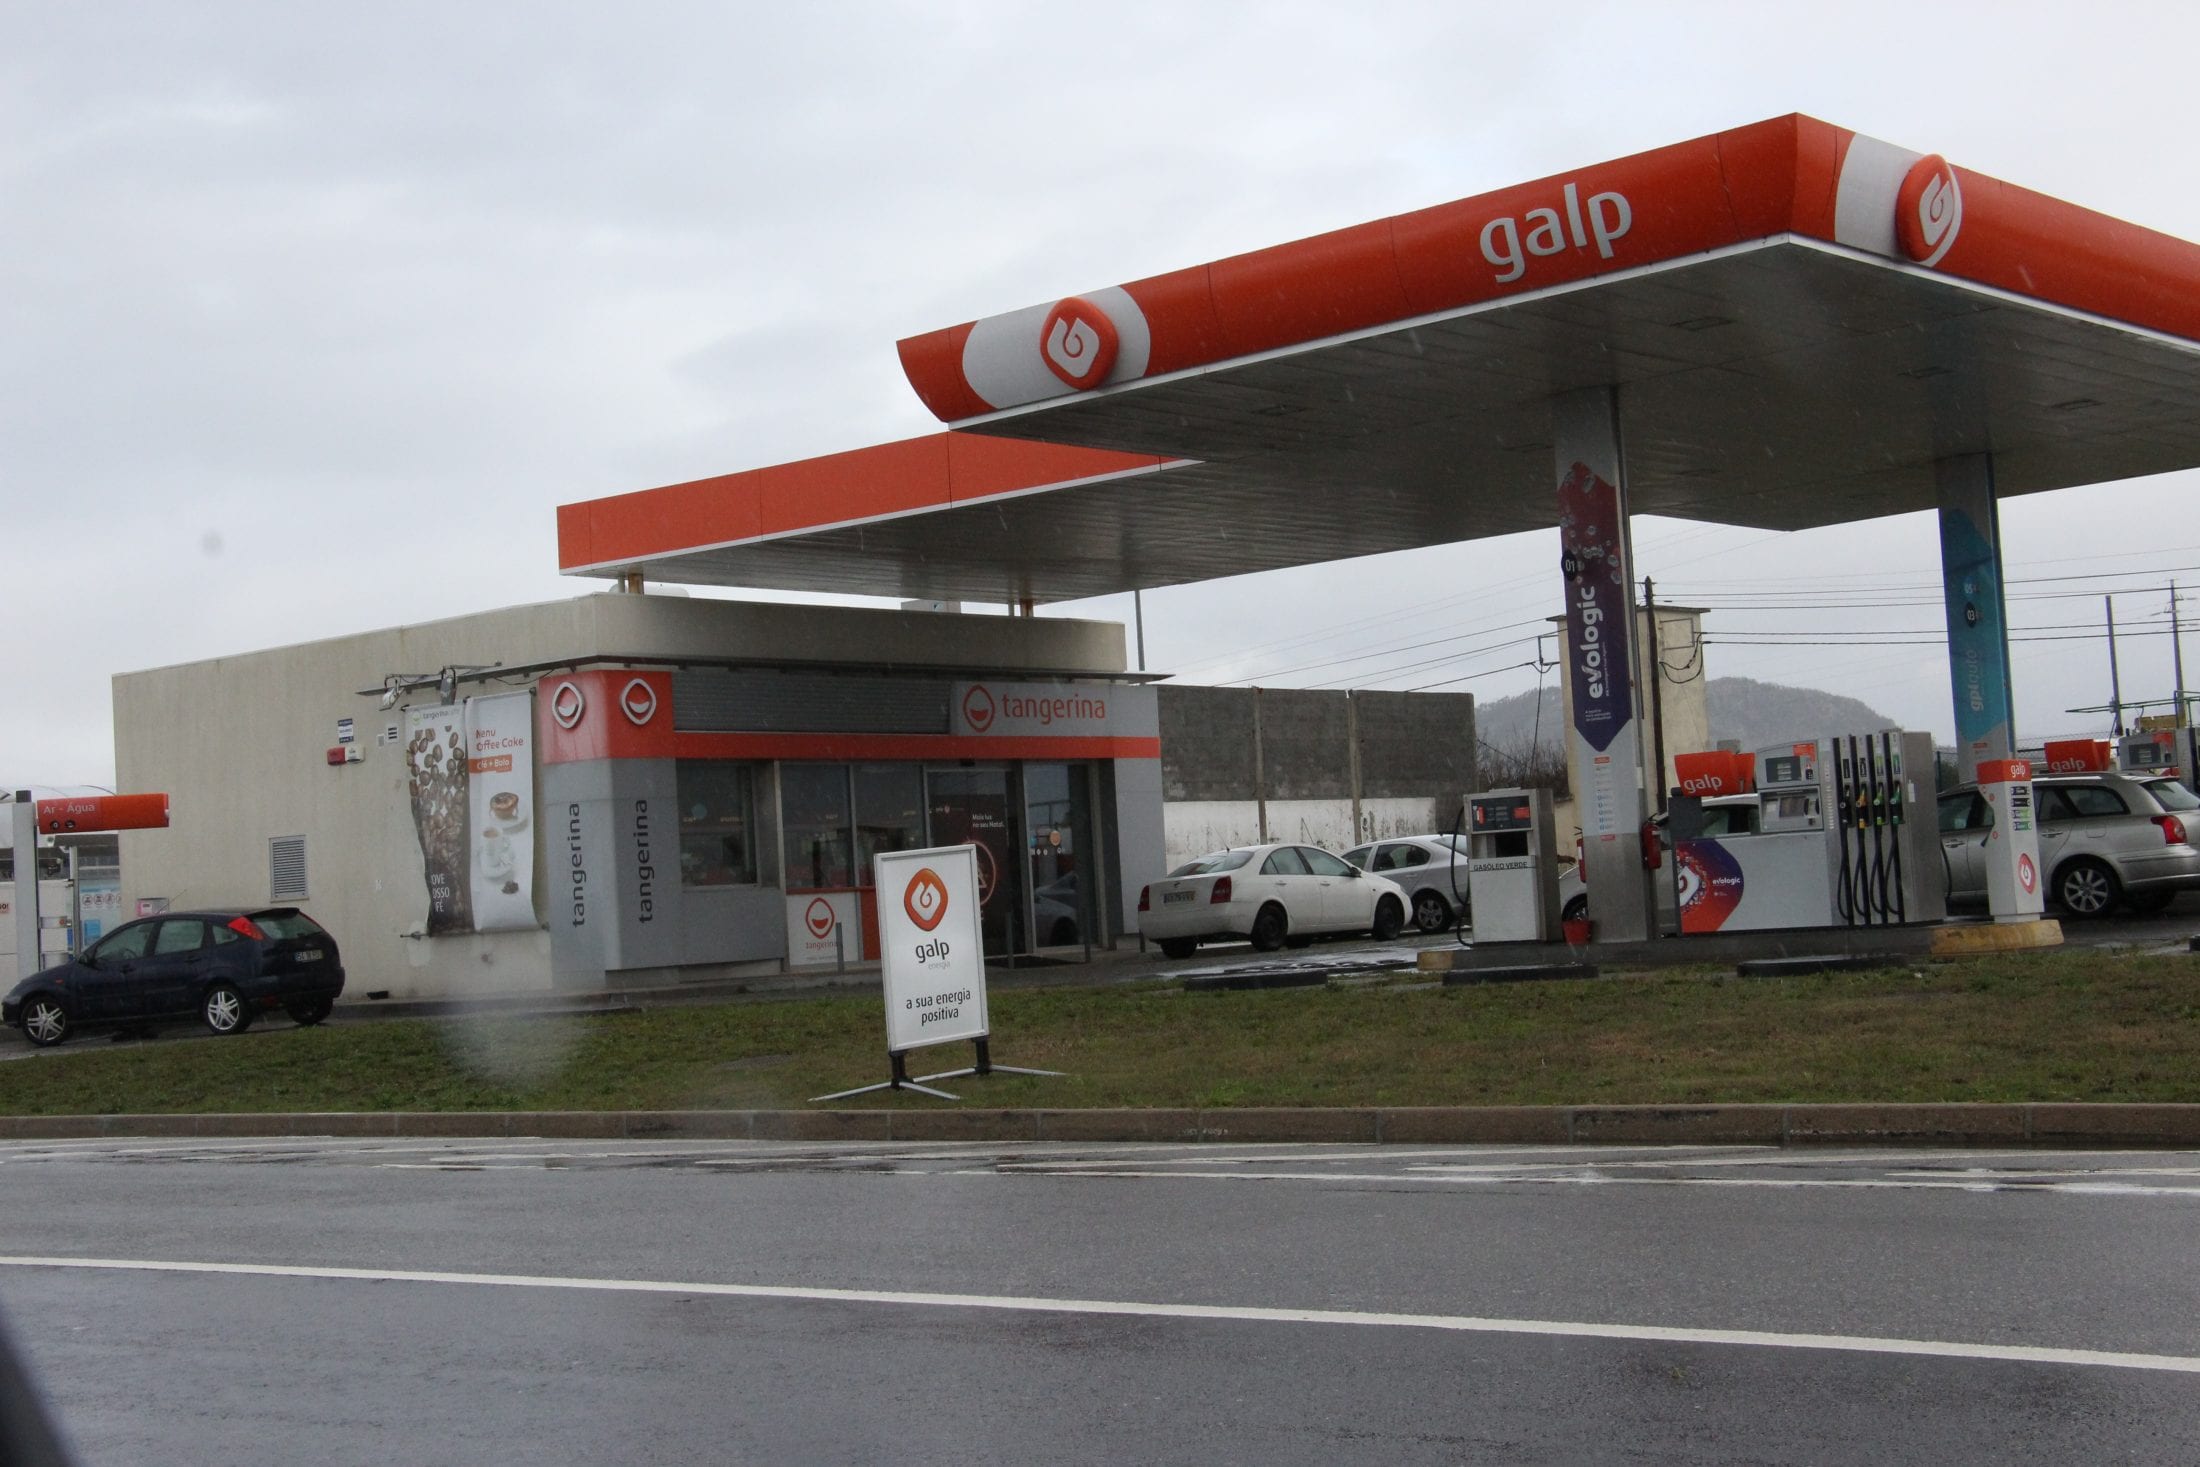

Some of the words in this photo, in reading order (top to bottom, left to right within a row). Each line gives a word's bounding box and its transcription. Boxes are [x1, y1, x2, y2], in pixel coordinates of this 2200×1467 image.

[1479, 182, 1632, 283] galp
[1576, 586, 1604, 699] evologic
[1001, 692, 1105, 725] tangerina
[2010, 762, 2026, 778] galp
[2051, 757, 2086, 772] galp
[1683, 773, 1723, 794] galp
[43, 805, 55, 814] Ar
[66, 802, 96, 815] Água
[568, 803, 587, 928] tangerina
[633, 800, 655, 924] tangerina
[1712, 876, 1741, 886] evologic
[915, 938, 950, 964] galp
[906, 998, 913, 1009] a
[916, 995, 933, 1008] sua
[936, 987, 971, 1005] energia
[921, 1006, 959, 1027] positiva
